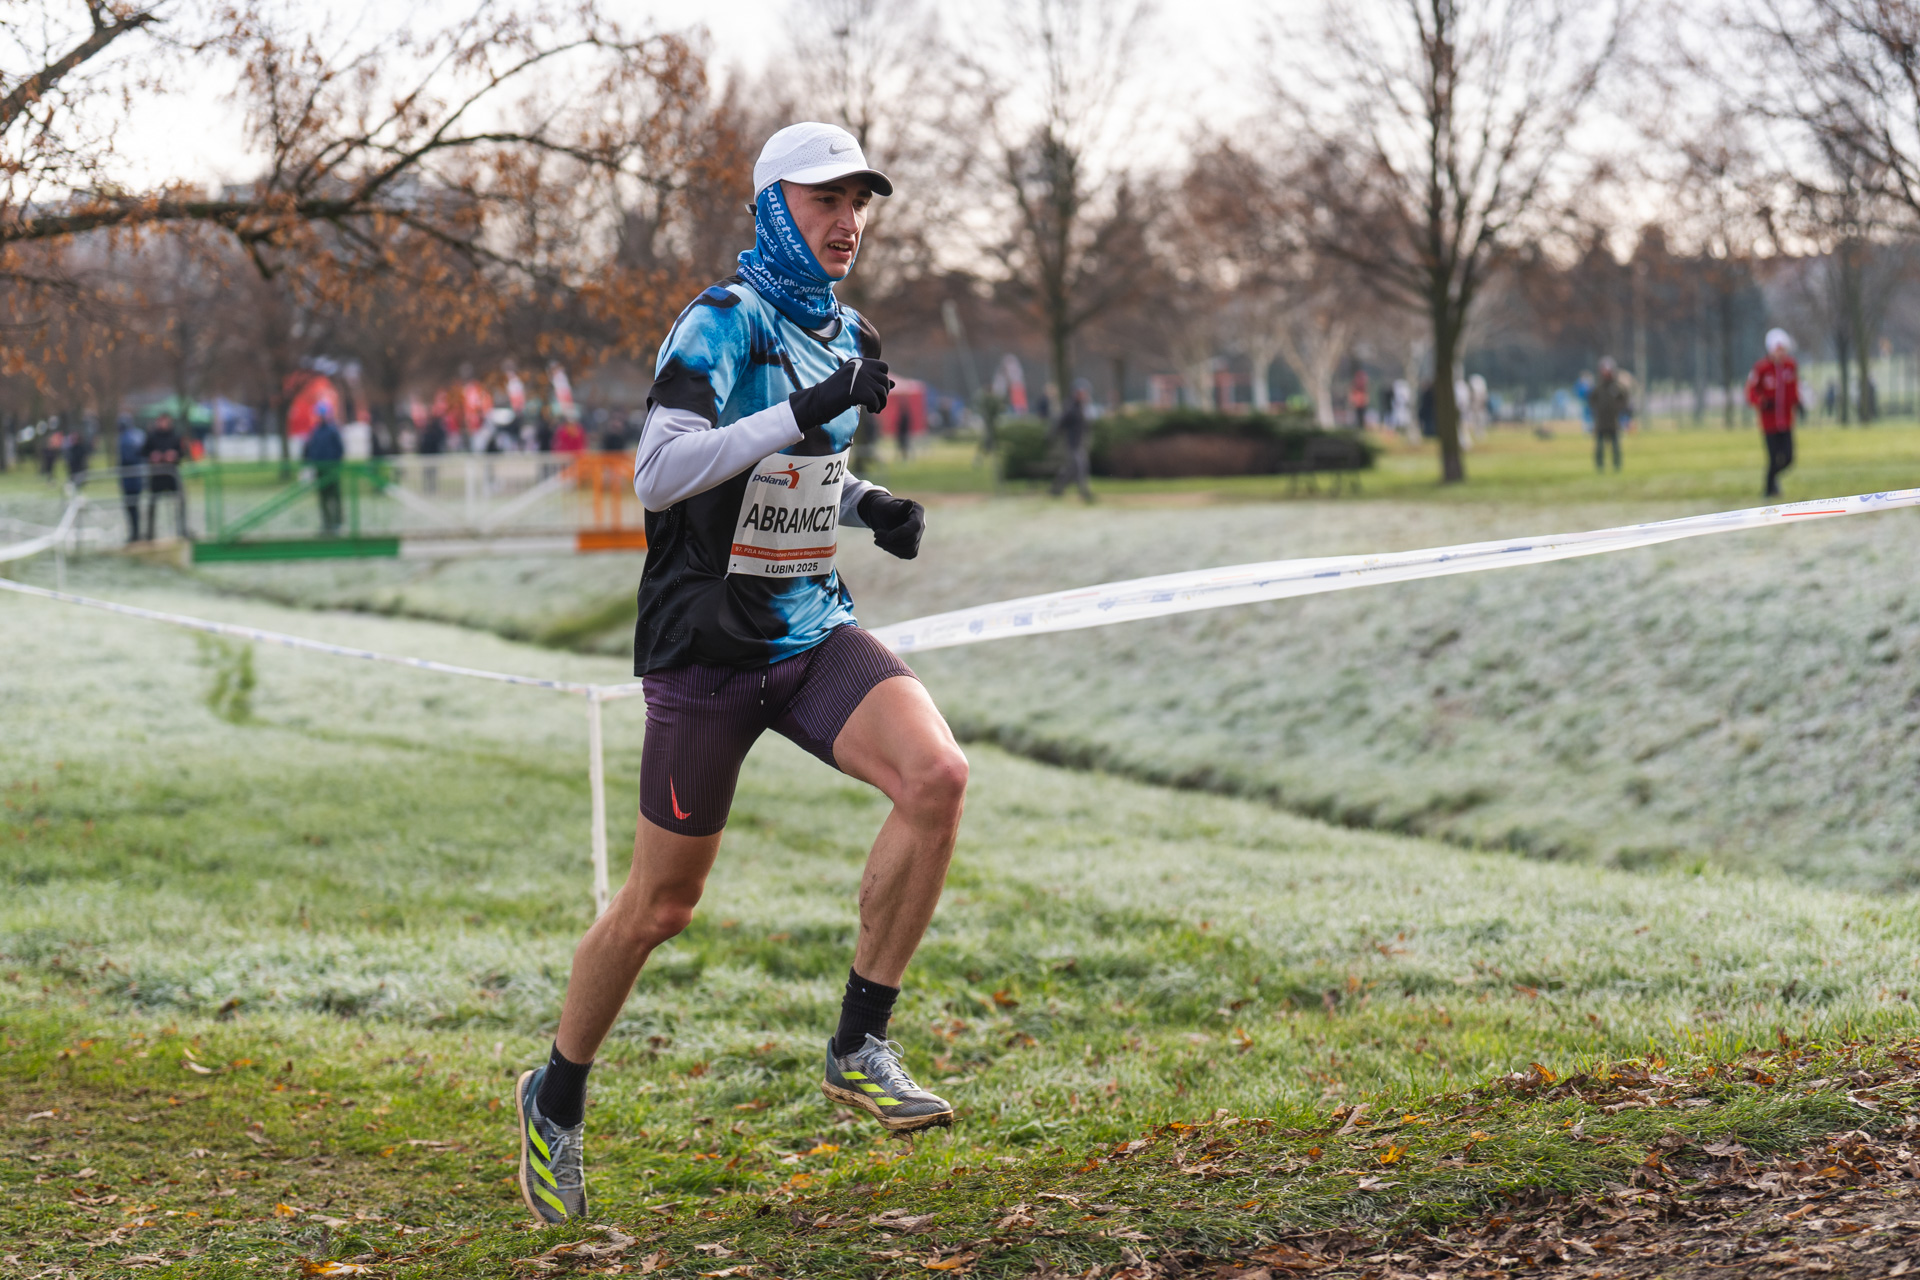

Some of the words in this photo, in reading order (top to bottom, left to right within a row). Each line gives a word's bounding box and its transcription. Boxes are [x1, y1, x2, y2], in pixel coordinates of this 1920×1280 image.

[752, 473, 791, 487] polanik
[742, 503, 840, 534] ABRAMCZY
[765, 563, 794, 574] LUBIN
[796, 562, 818, 572] 2025
